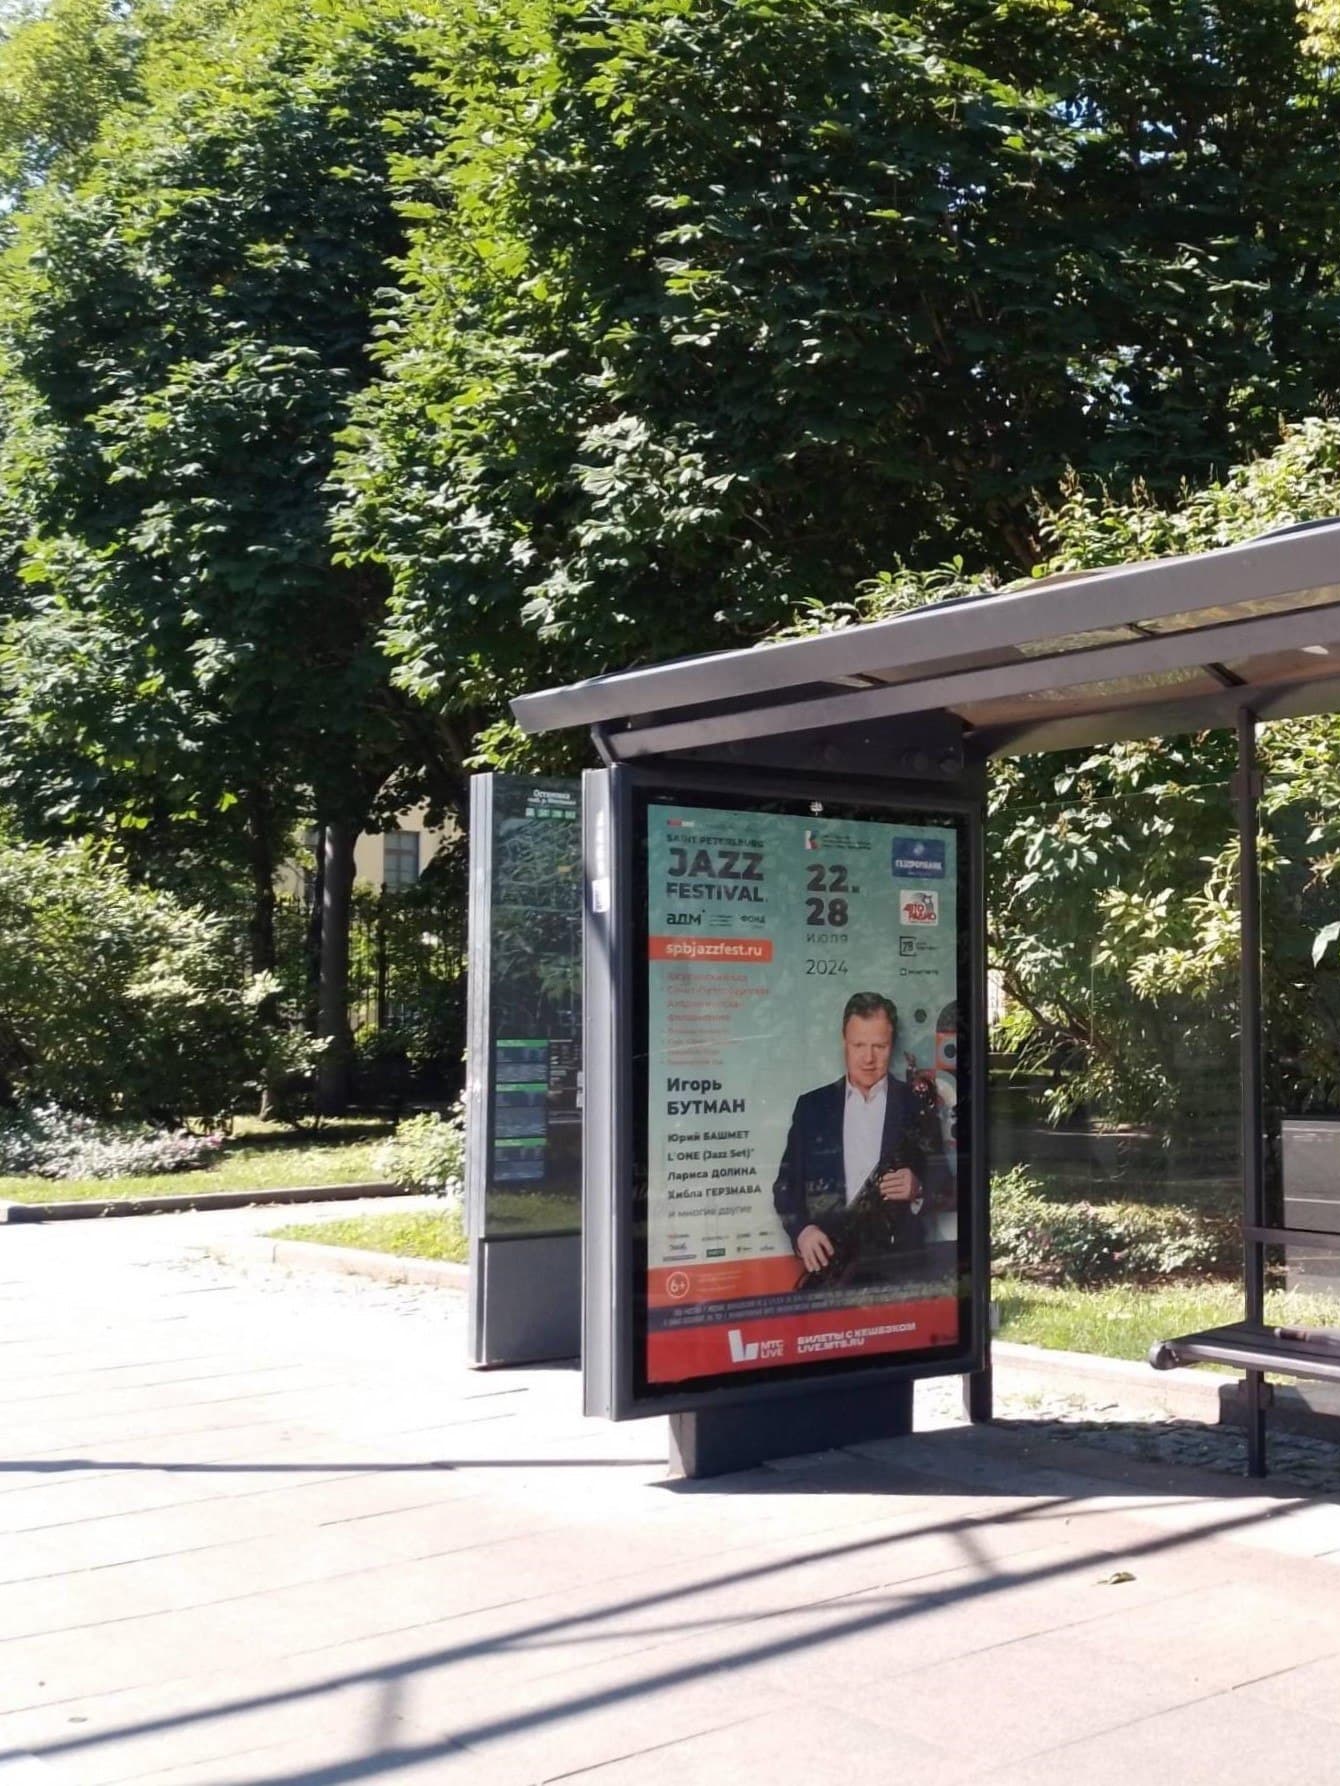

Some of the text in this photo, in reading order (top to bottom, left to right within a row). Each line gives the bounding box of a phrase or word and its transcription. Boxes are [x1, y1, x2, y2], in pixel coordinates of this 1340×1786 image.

[667, 847, 764, 881] JAZZ
[805, 897, 849, 928] 28
[666, 941, 763, 958] spbjazzfest.ru
[805, 959, 849, 976] 2024
[667, 1078, 722, 1094] Игорь
[667, 1099, 745, 1116] БУТМАН
[668, 1130, 750, 1144] Юрий БАШМЕТ
[667, 1167, 757, 1181] Лариса ДОЛИНА
[667, 1184, 762, 1200] Хибла ГЕРЗМАВА
[797, 1331, 844, 1345] БИЛЕТЫ
[760, 1348, 784, 1359] LIVE
